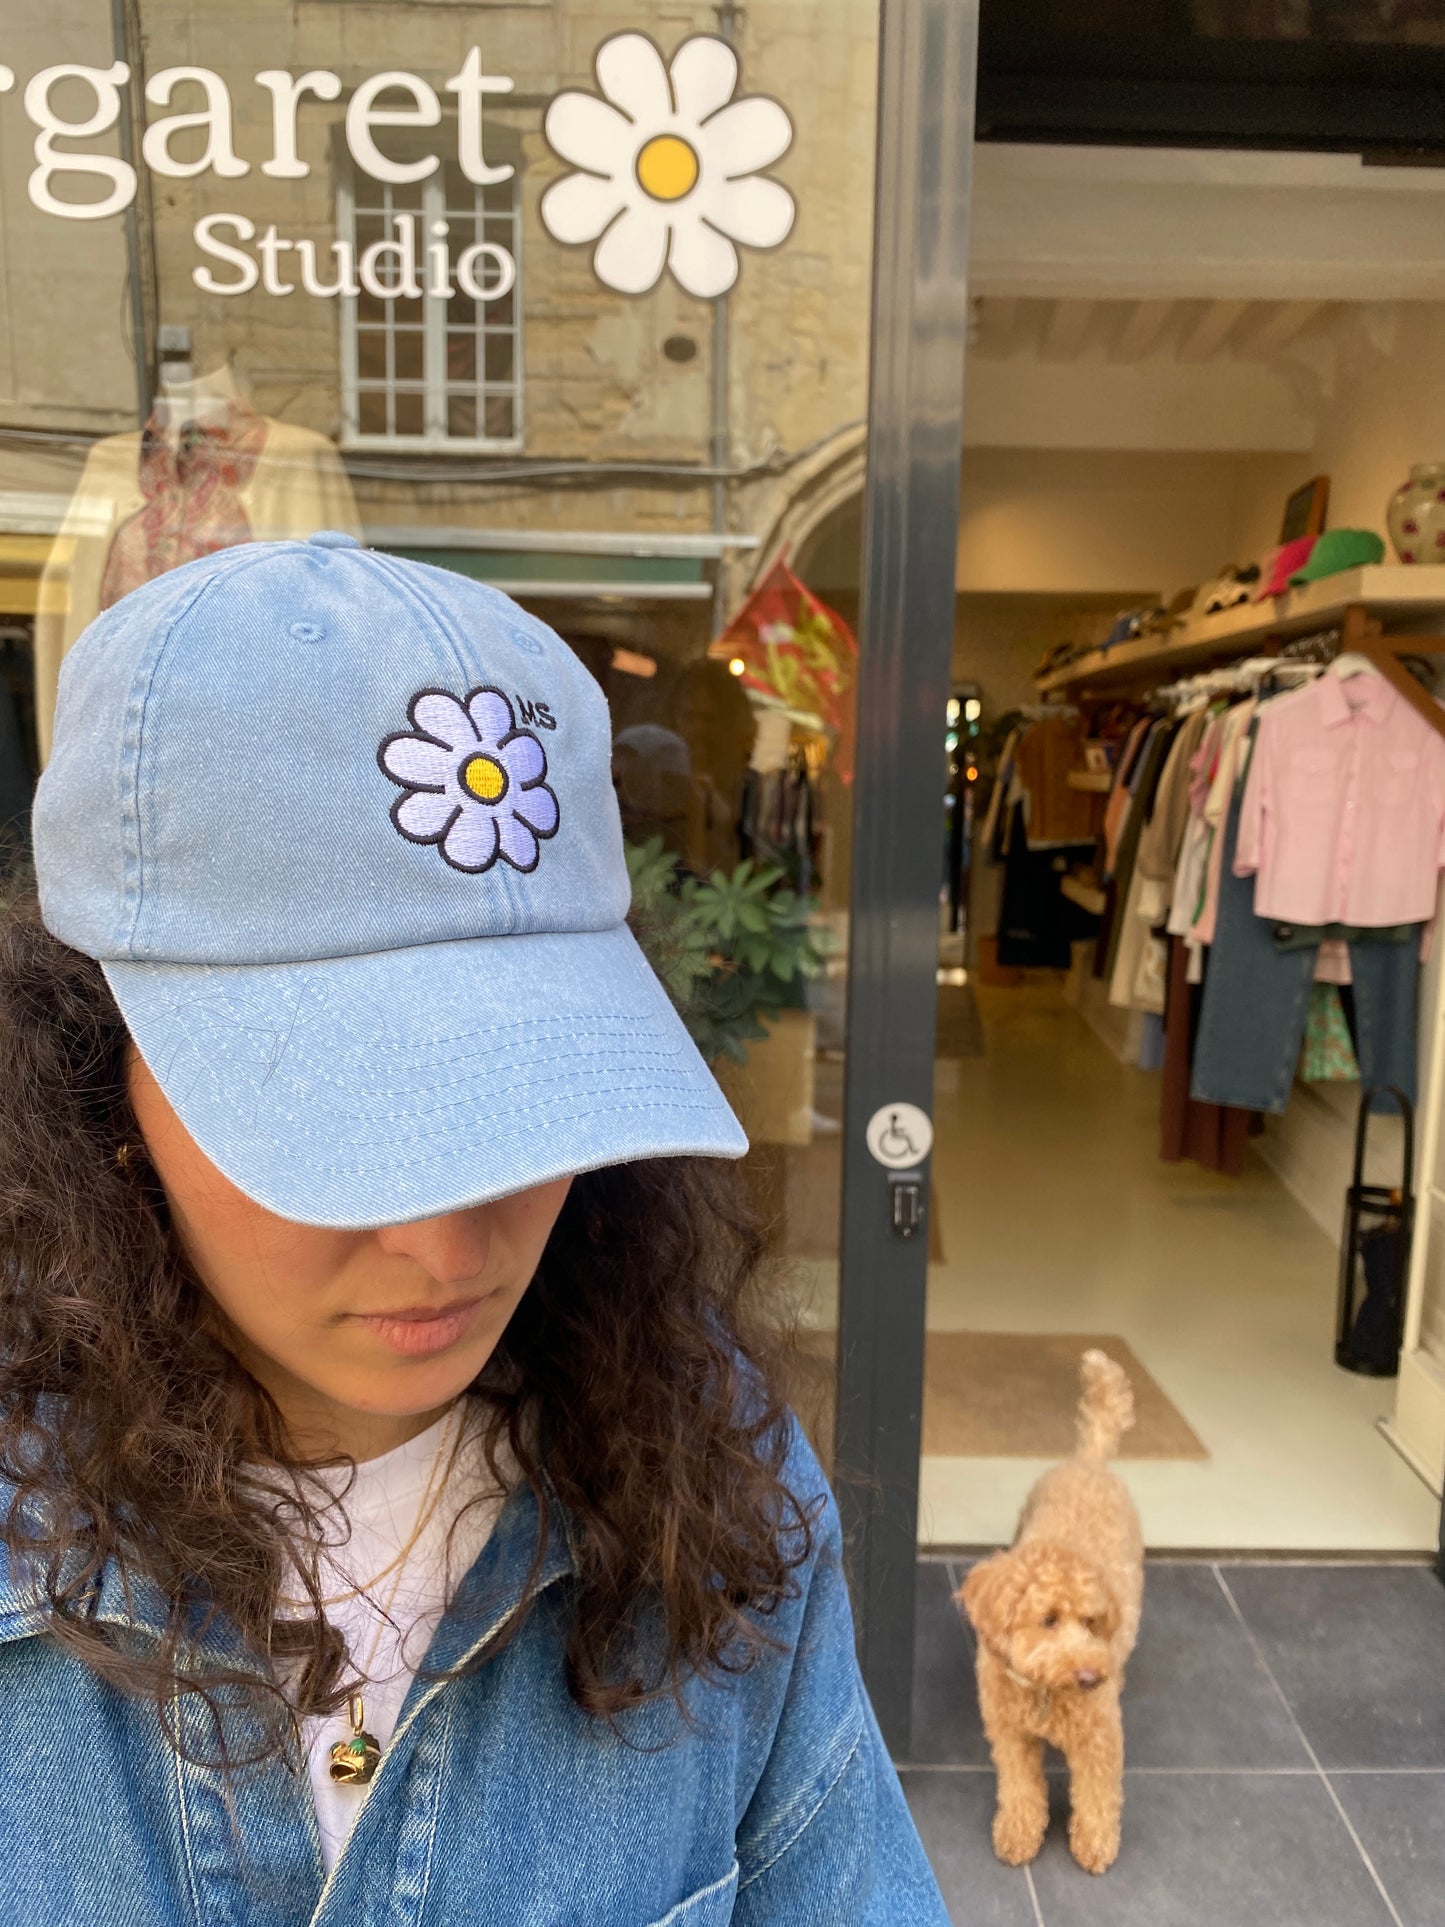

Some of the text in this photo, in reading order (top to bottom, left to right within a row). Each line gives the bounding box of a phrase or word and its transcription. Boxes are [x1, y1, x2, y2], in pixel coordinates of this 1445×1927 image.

[0, 46, 515, 219] garet
[193, 213, 515, 300] Studio
[516, 695, 557, 730] MS
